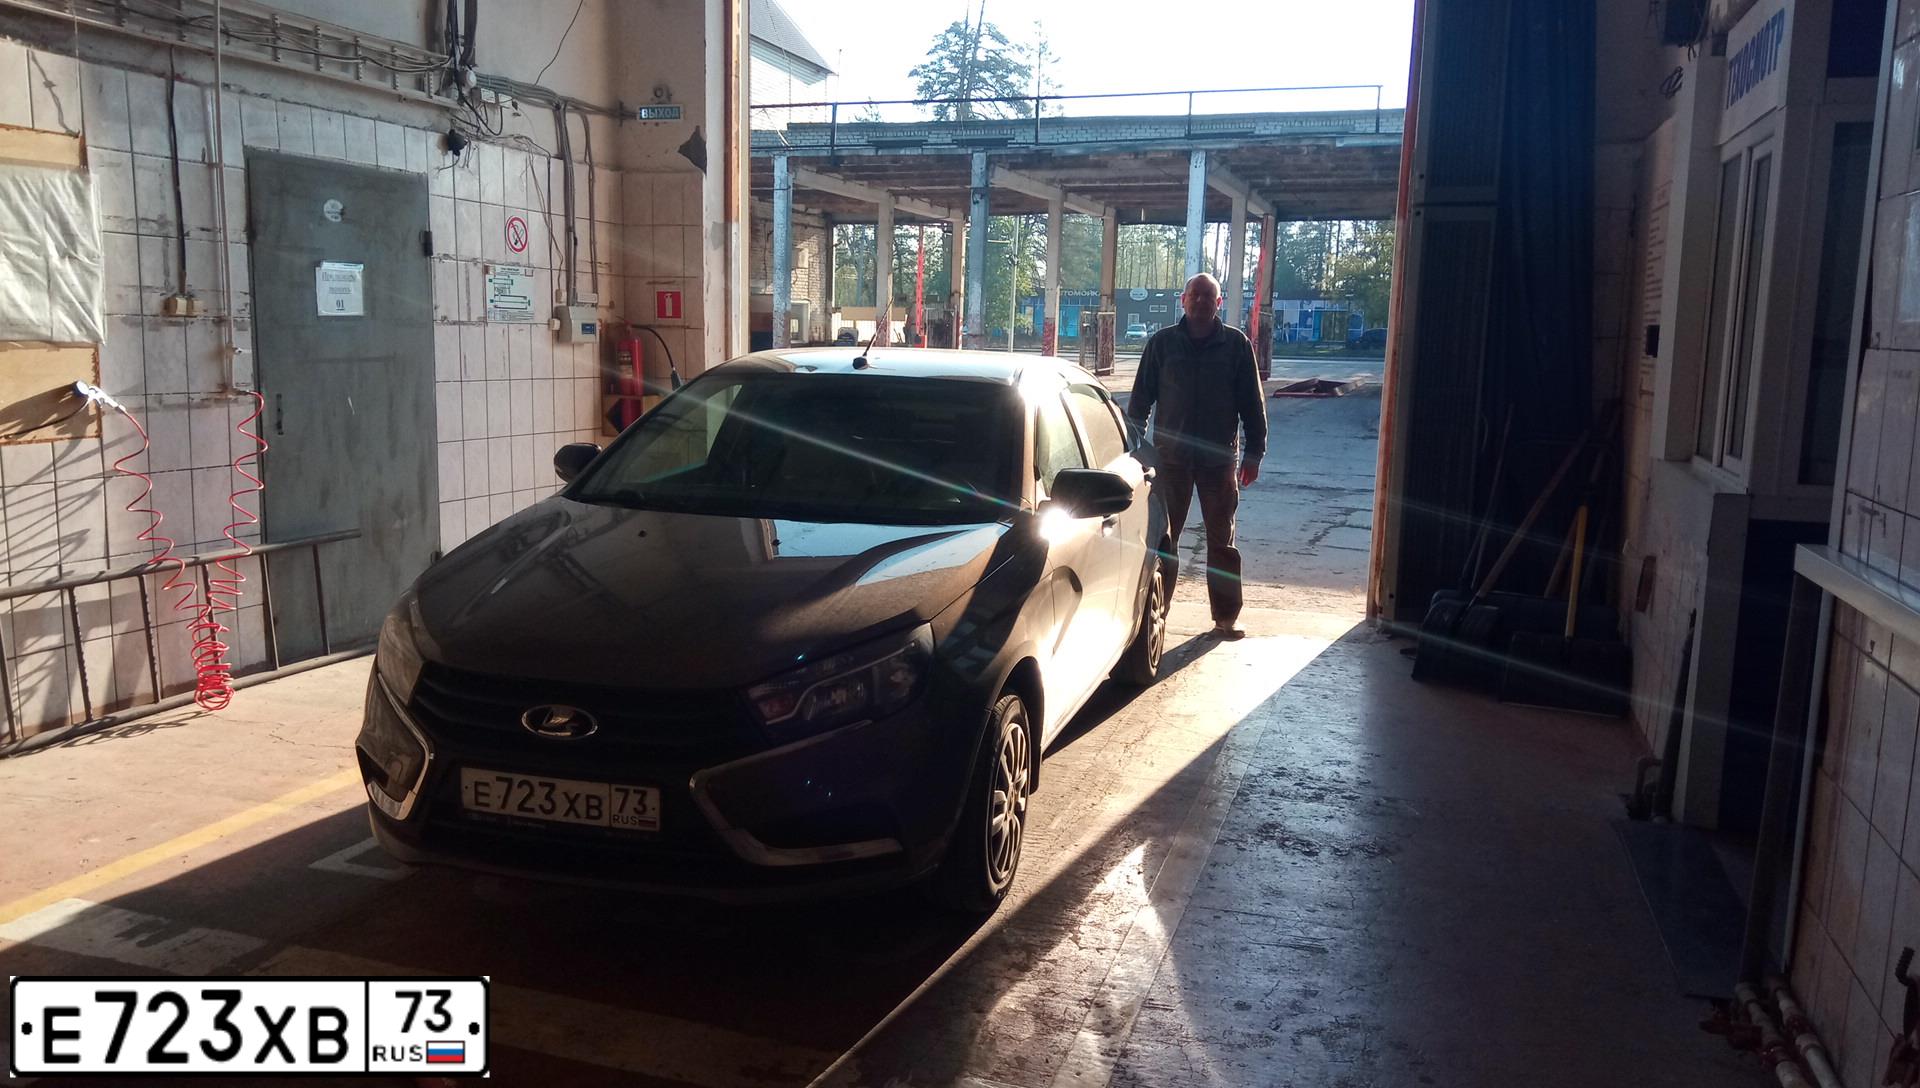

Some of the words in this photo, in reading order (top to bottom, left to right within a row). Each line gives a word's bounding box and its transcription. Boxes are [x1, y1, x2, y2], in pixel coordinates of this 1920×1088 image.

[1726, 8, 1785, 110] ТЕХОСМОТР
[641, 108, 679, 118] ВЫХОД
[336, 299, 345, 308] 01
[474, 776, 602, 820] Е723ХВ
[614, 787, 648, 814] 73
[612, 814, 638, 826] RUS
